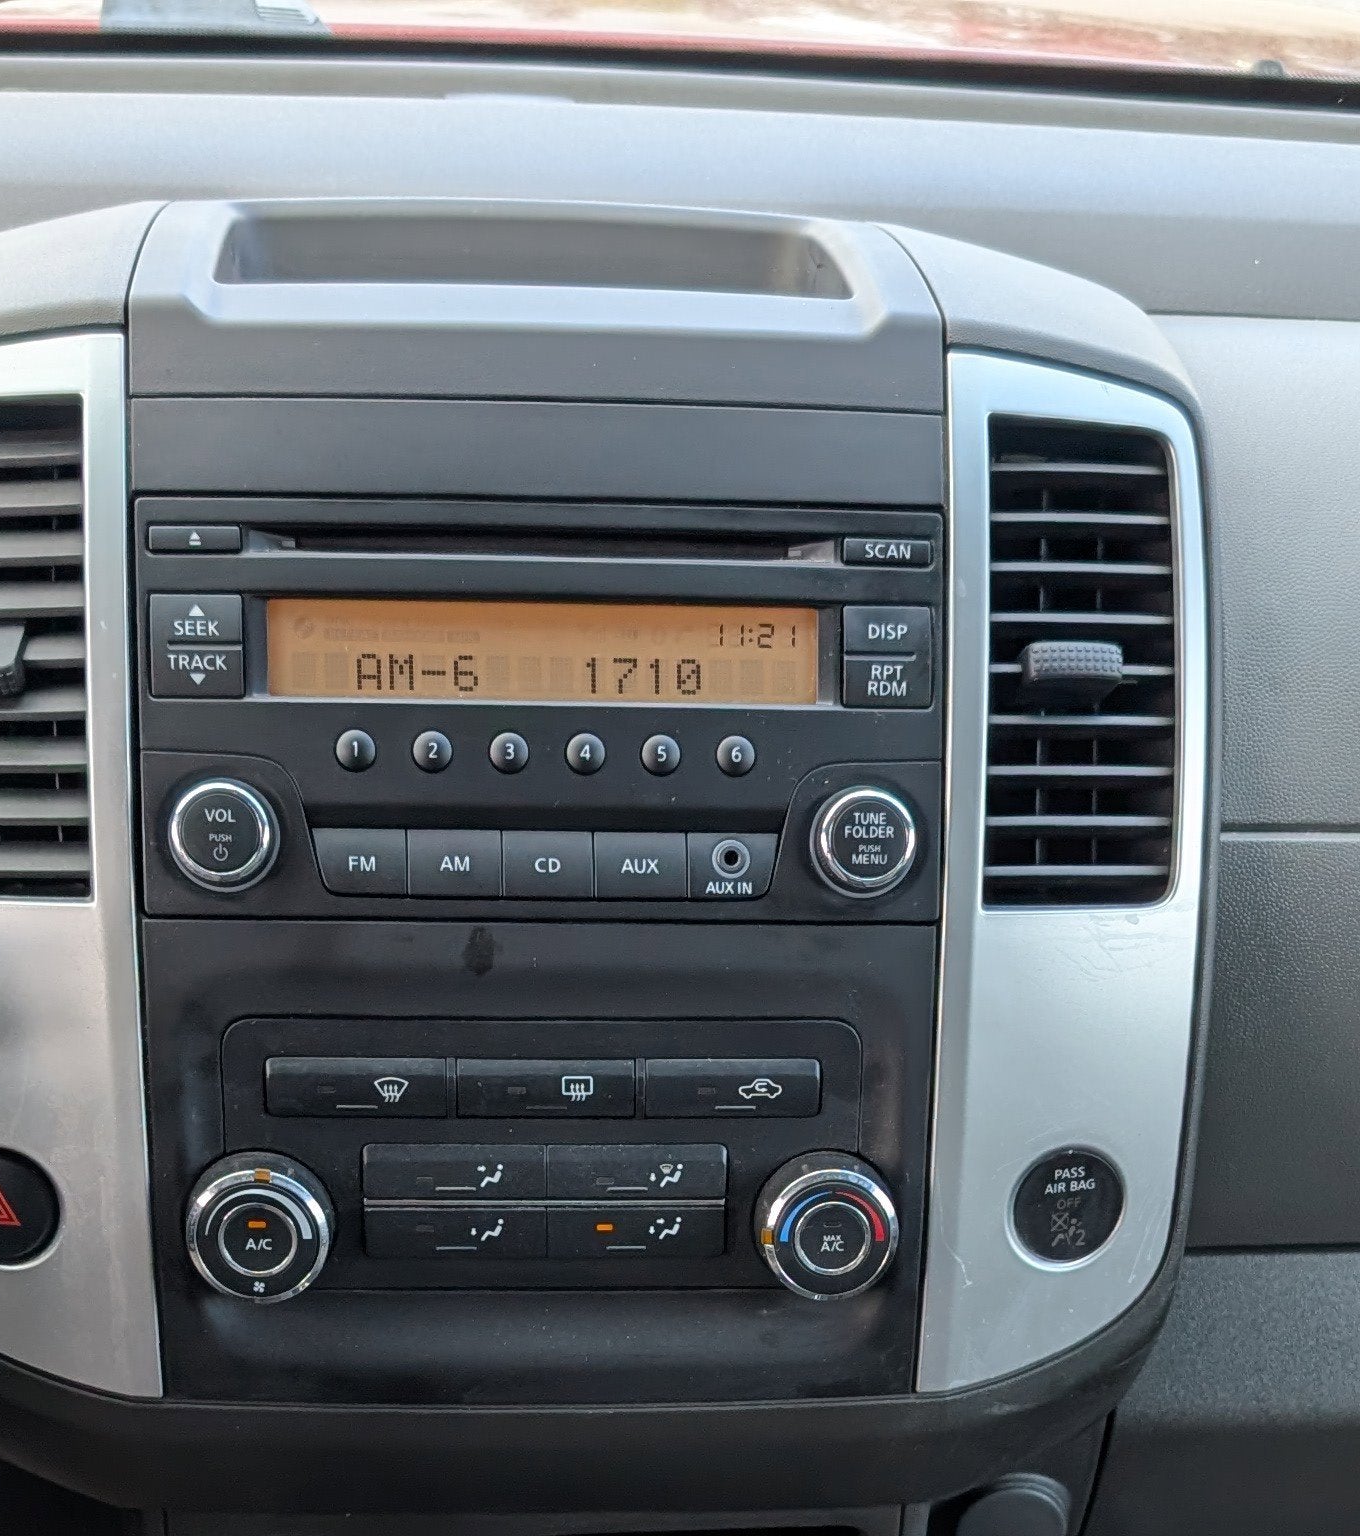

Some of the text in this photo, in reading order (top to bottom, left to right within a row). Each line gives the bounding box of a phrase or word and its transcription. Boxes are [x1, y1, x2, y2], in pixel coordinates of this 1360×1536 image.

[864, 544, 912, 560] SCAN
[173, 619, 220, 637] SEEK
[714, 623, 797, 649] 11:21
[868, 623, 909, 641] DISP
[167, 654, 227, 672] TRACK
[357, 653, 702, 695] AM-6 1710
[871, 665, 903, 680] RPT
[867, 681, 908, 697] RDM
[350, 741, 359, 758] 1
[428, 742, 438, 759] 2
[504, 743, 515, 760] 3
[579, 745, 591, 761] 4
[657, 745, 667, 762] 5
[731, 746, 742, 763] 6
[204, 808, 237, 824] VOL
[852, 812, 888, 826] TUNE
[208, 833, 233, 843] PUSH
[844, 825, 895, 839] FOLDER
[858, 844, 882, 853] PUSH
[348, 856, 377, 872] FM
[439, 856, 471, 872] AM
[534, 858, 561, 873] CD
[620, 858, 660, 875] AUX
[851, 853, 888, 865] MENU
[705, 881, 752, 895] AUX IN
[1054, 1166, 1086, 1181] PASS
[1044, 1178, 1096, 1195] AIR BAG
[1056, 1197, 1081, 1210] OFF
[245, 1237, 273, 1252] A/C
[823, 1234, 841, 1243] MAX
[820, 1241, 845, 1253] A/C
